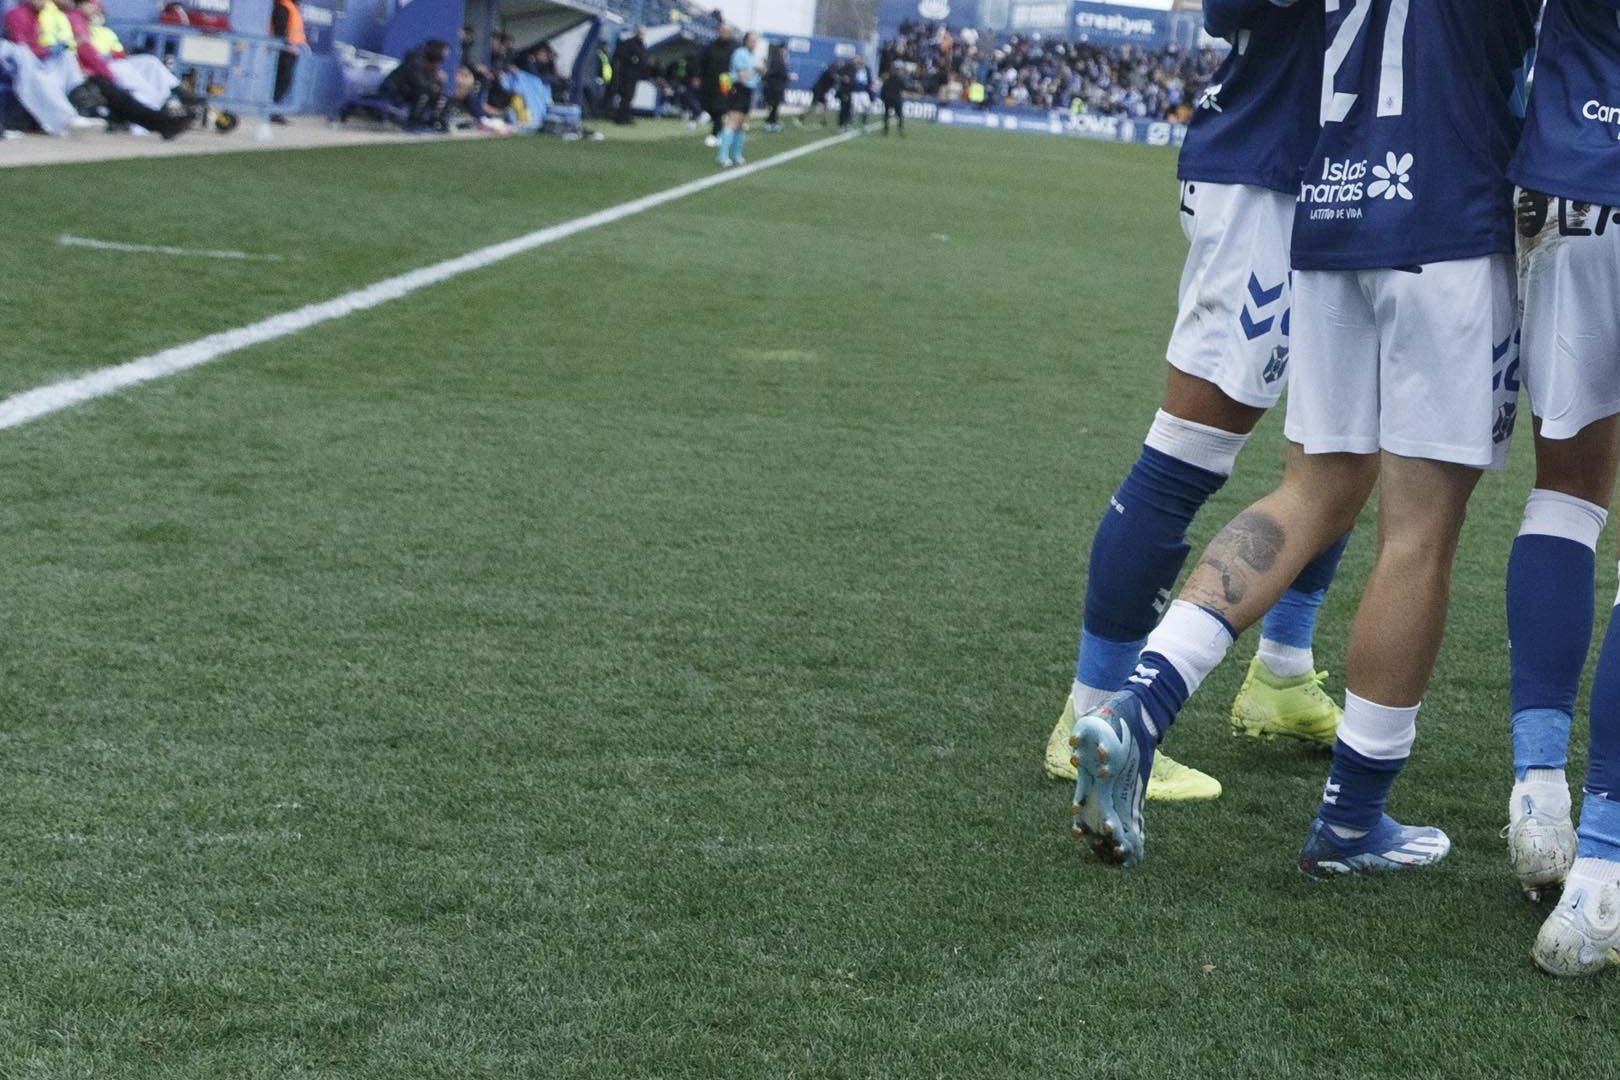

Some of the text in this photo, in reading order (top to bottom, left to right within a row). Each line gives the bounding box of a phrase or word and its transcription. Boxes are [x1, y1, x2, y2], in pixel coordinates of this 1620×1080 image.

[1322, 157, 1368, 181] Islas
[1296, 180, 1364, 203] narias
[1345, 207, 1363, 219] VIDA
